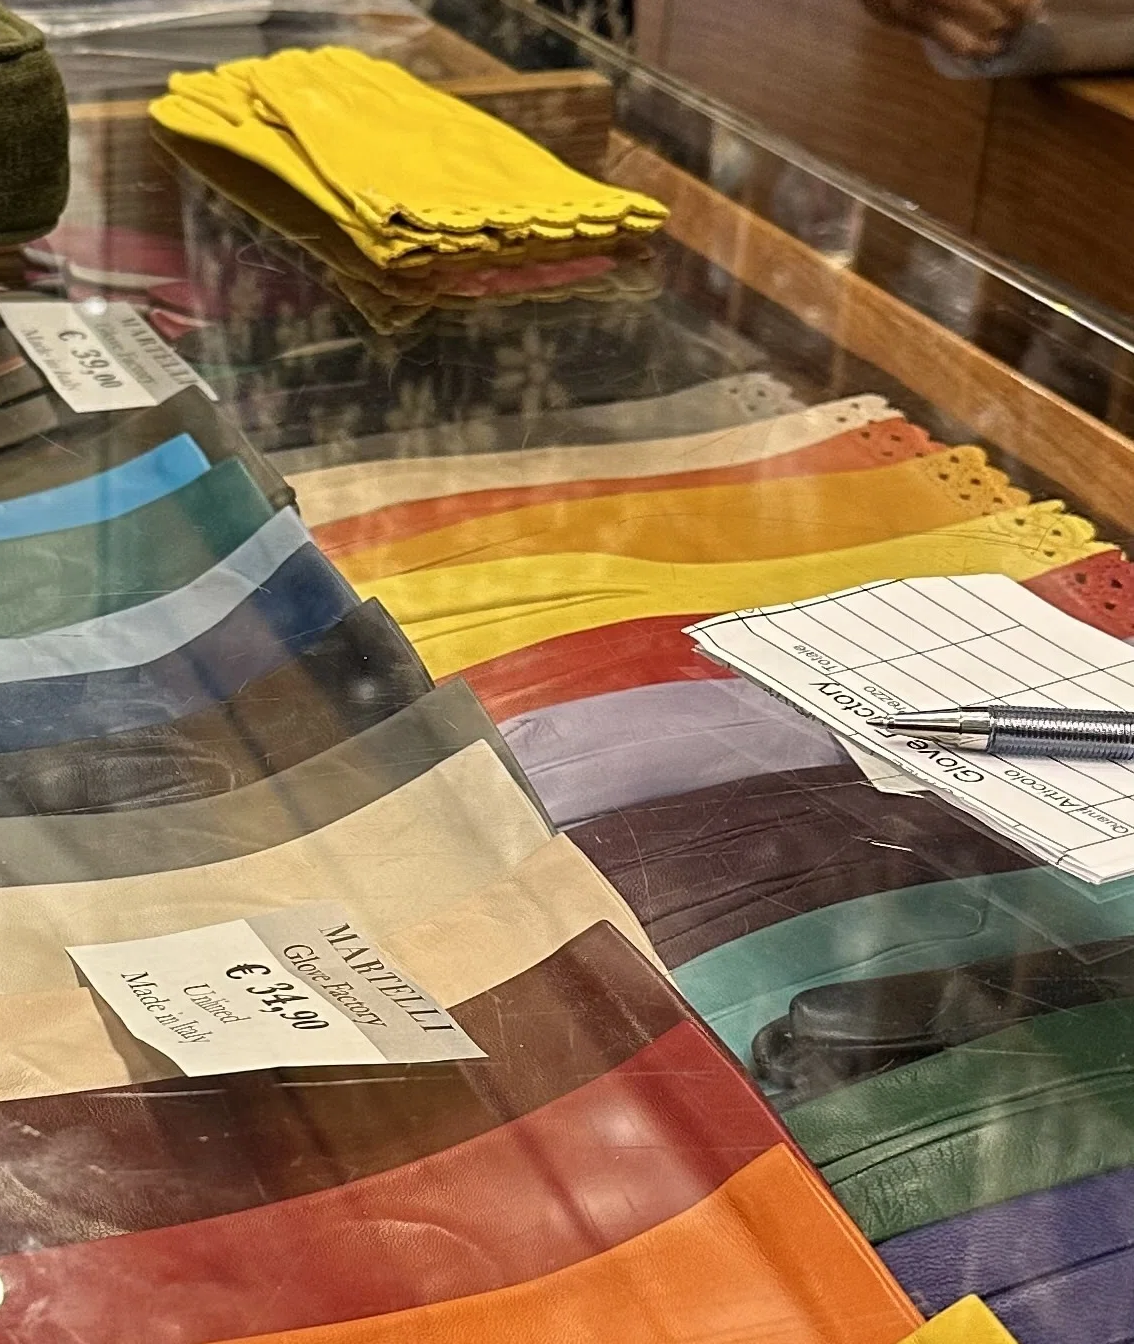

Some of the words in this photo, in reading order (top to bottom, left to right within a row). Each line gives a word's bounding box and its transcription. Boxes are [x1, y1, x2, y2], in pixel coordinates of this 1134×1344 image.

[70, 348, 123, 390] 39,00
[121, 316, 198, 385] MARTELLI
[793, 644, 839, 672] Totale
[809, 682, 896, 739] ctory
[863, 685, 908, 714] rezzo
[907, 739, 985, 783] Glove
[1004, 769, 1080, 807] Articolo
[225, 962, 271, 980] €
[282, 943, 322, 984] Glove
[321, 981, 387, 1030] Factory
[316, 921, 457, 1035] MARTELLI
[121, 971, 167, 1014] Made
[168, 1019, 211, 1046] Italy
[182, 982, 252, 1026] Unlined
[246, 982, 331, 1032] 34,90
